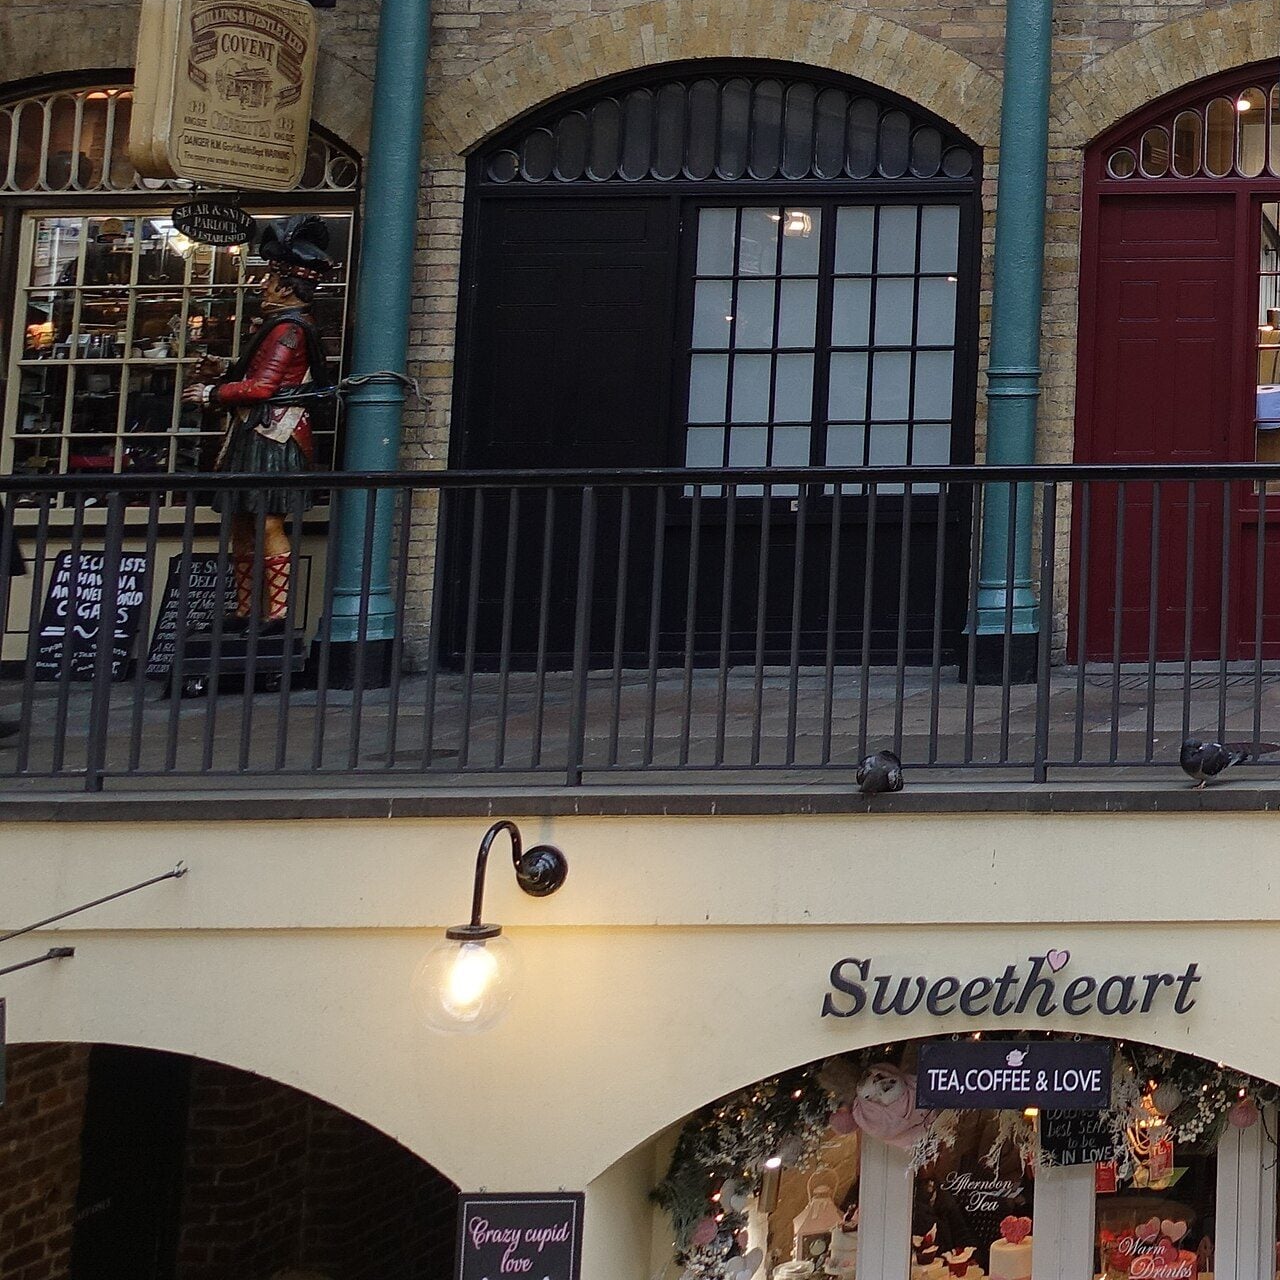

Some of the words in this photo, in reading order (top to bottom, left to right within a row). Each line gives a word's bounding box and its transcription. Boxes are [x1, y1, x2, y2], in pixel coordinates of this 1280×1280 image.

[221, 33, 275, 66] COVENT
[184, 135, 209, 148] DANGER
[194, 217, 238, 233] PARLOUR
[820, 955, 1202, 1019] Sweetheart
[1036, 1069, 1049, 1092] &
[1054, 1069, 1102, 1092] LOVE
[1061, 1149, 1076, 1164] IN
[1082, 1145, 1114, 1163] LOVE
[940, 1170, 1014, 1196] Afternoon
[965, 1191, 1000, 1213] Tea
[468, 1216, 522, 1252] Crazy
[525, 1221, 570, 1252] cupid
[1118, 1235, 1166, 1257] Warm
[500, 1249, 534, 1274] love
[1128, 1256, 1194, 1280] Drinks
